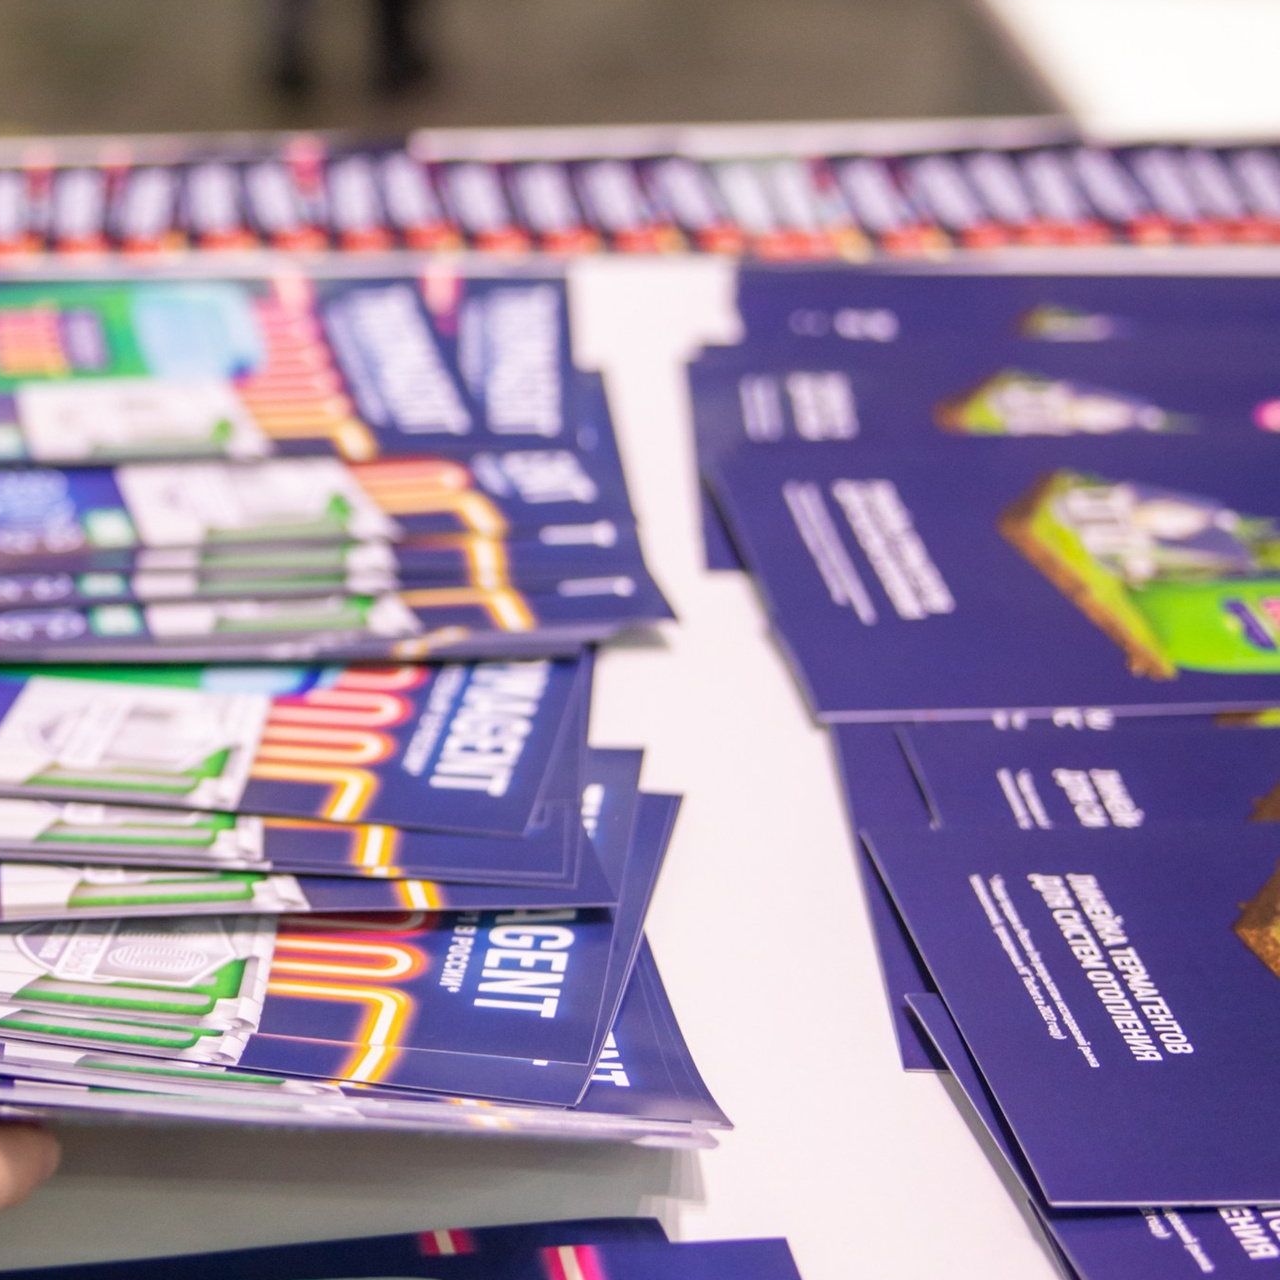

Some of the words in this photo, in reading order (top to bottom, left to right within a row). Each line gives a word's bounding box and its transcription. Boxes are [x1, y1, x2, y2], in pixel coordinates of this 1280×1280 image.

[1027, 873, 1076, 909] ДЛЯ
[1052, 909, 1108, 969] СИСТЕМ
[1086, 970, 1163, 1061] ОТОПЛЕНИЯ
[1065, 873, 1129, 947] ЛИНЕЙКА
[1108, 946, 1195, 1054] ТЕРМАГЕНТОВ
